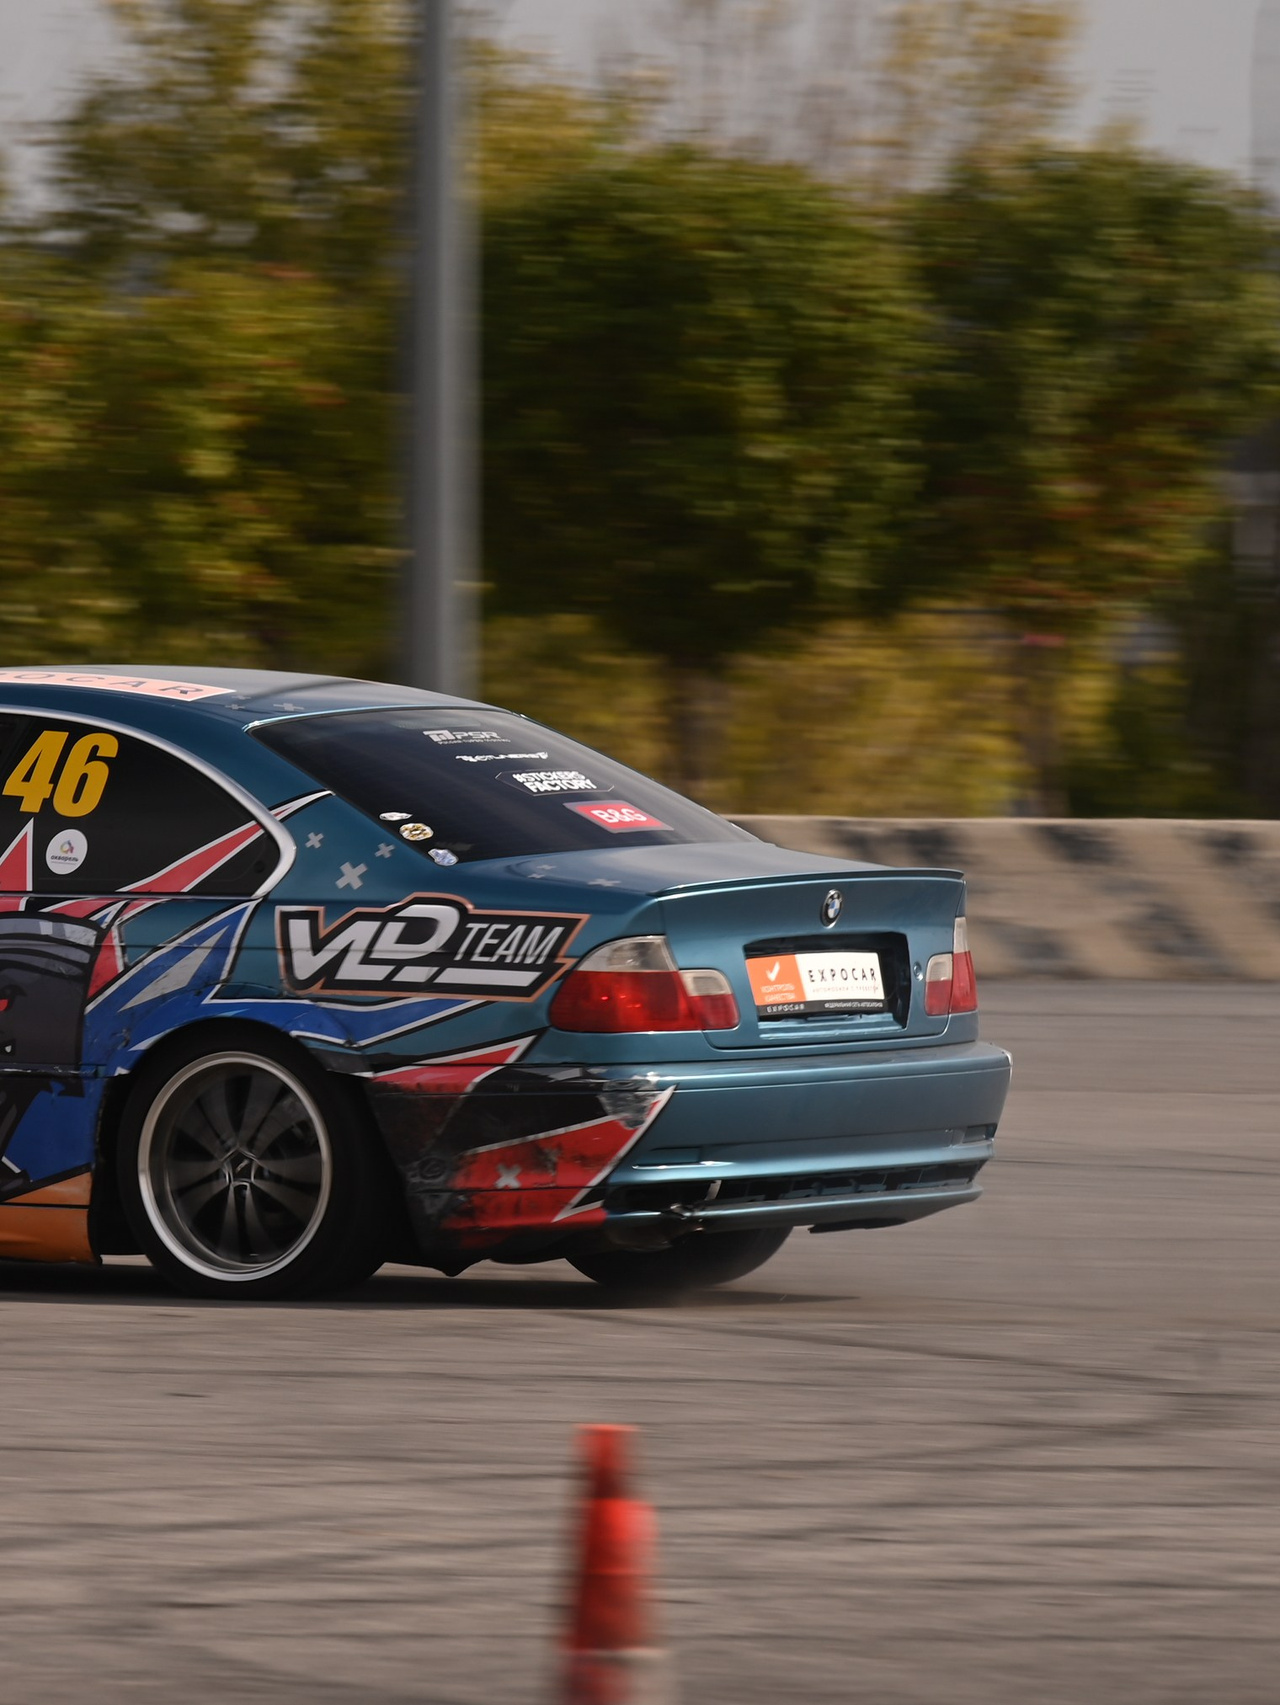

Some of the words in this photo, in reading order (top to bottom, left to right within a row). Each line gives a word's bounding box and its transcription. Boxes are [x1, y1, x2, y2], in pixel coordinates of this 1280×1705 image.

[2, 730, 119, 818] 46
[523, 779, 597, 793] FACTORY
[590, 808, 647, 824] B&G
[453, 922, 566, 965] TEAM
[808, 967, 877, 983] EXPOCAR
